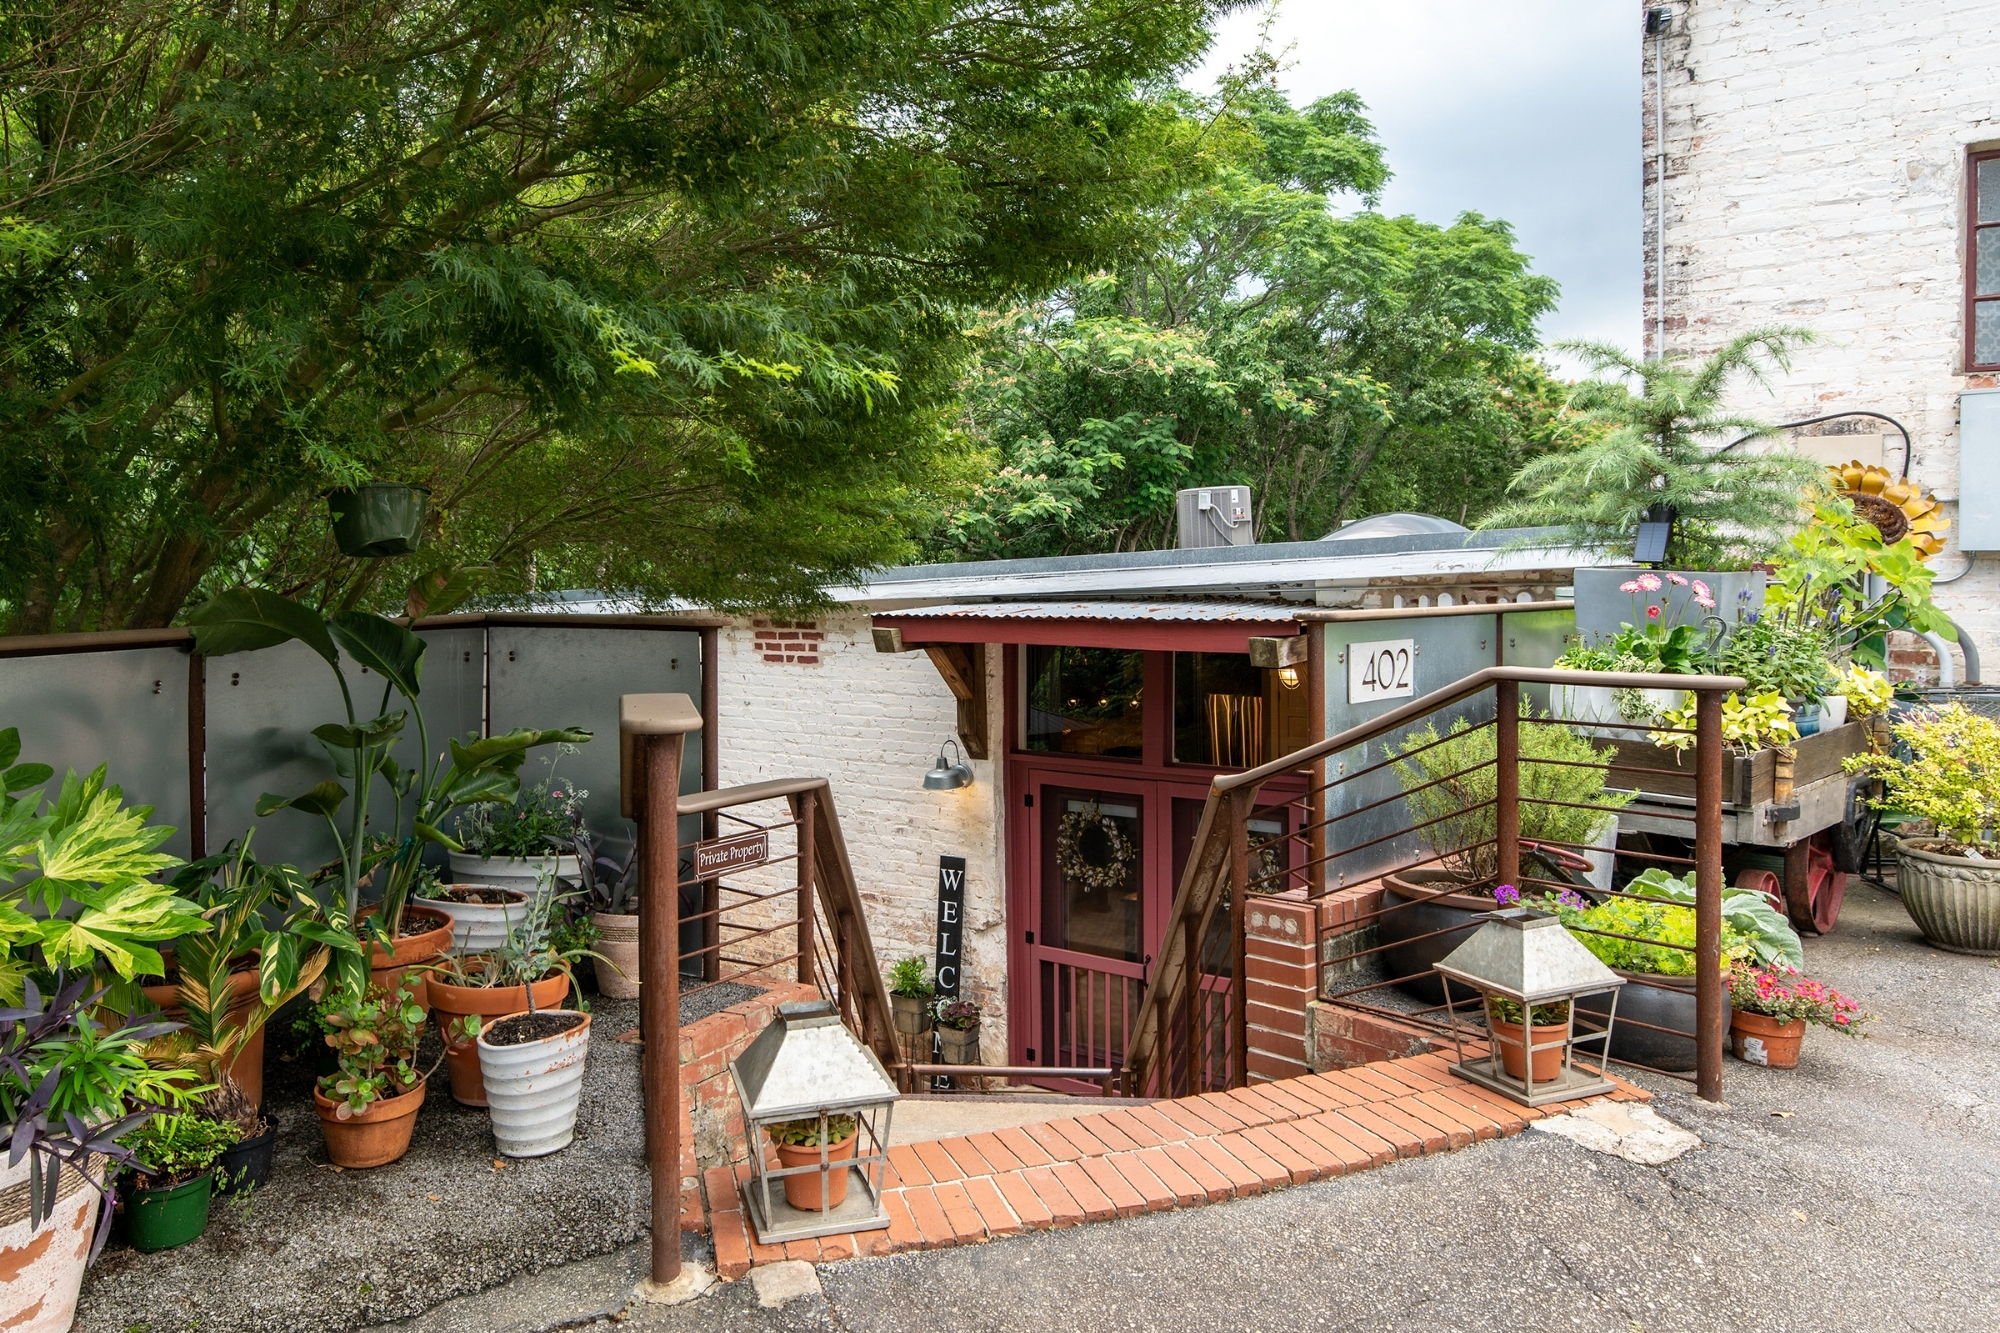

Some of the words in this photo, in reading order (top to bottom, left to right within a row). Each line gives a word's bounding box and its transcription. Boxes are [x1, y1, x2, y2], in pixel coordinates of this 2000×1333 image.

[1362, 648, 1409, 692] 402
[700, 850, 729, 867] Private
[730, 842, 764, 862] Property
